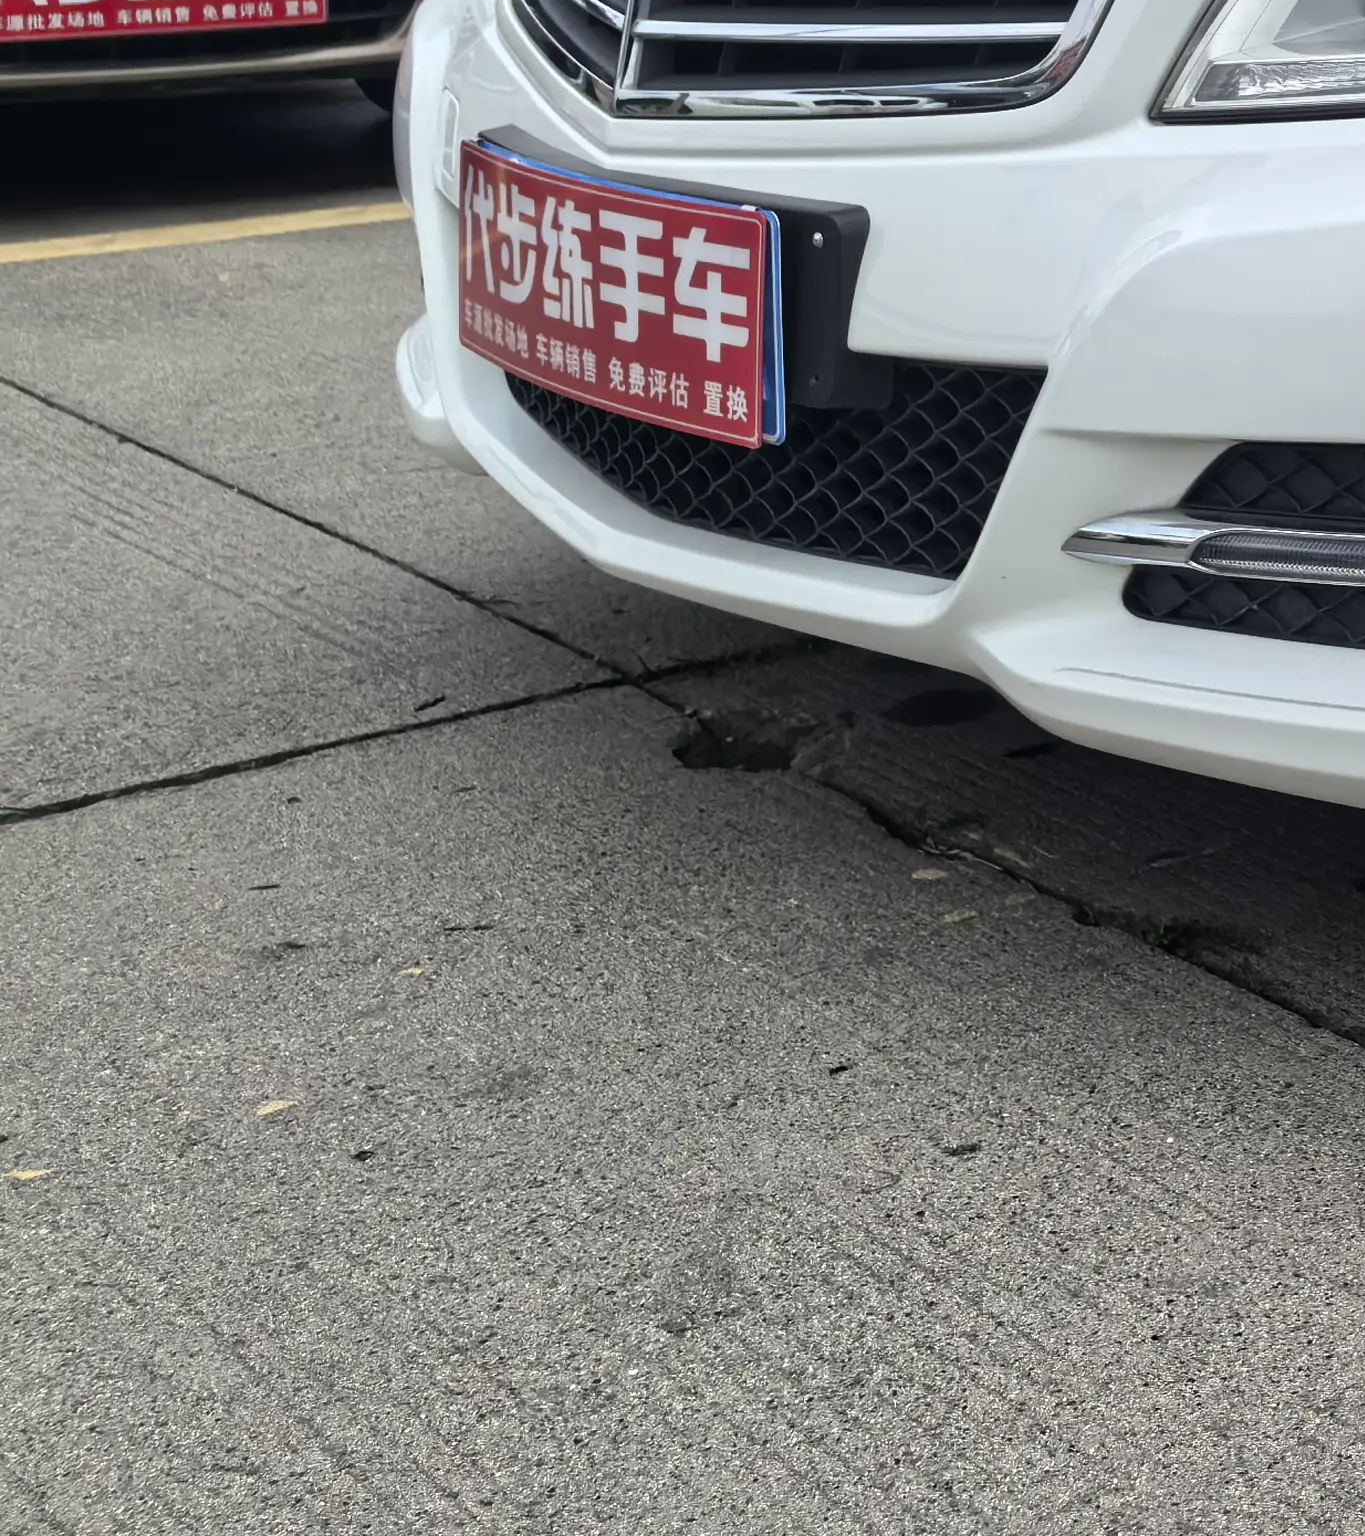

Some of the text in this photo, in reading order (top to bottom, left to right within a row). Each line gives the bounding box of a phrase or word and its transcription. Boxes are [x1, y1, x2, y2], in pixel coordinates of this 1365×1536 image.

[463, 164, 750, 364] 代步练手车
[535, 332, 597, 384] 车辆销售
[608, 357, 690, 409] 免费评估
[703, 380, 749, 423] 置换
